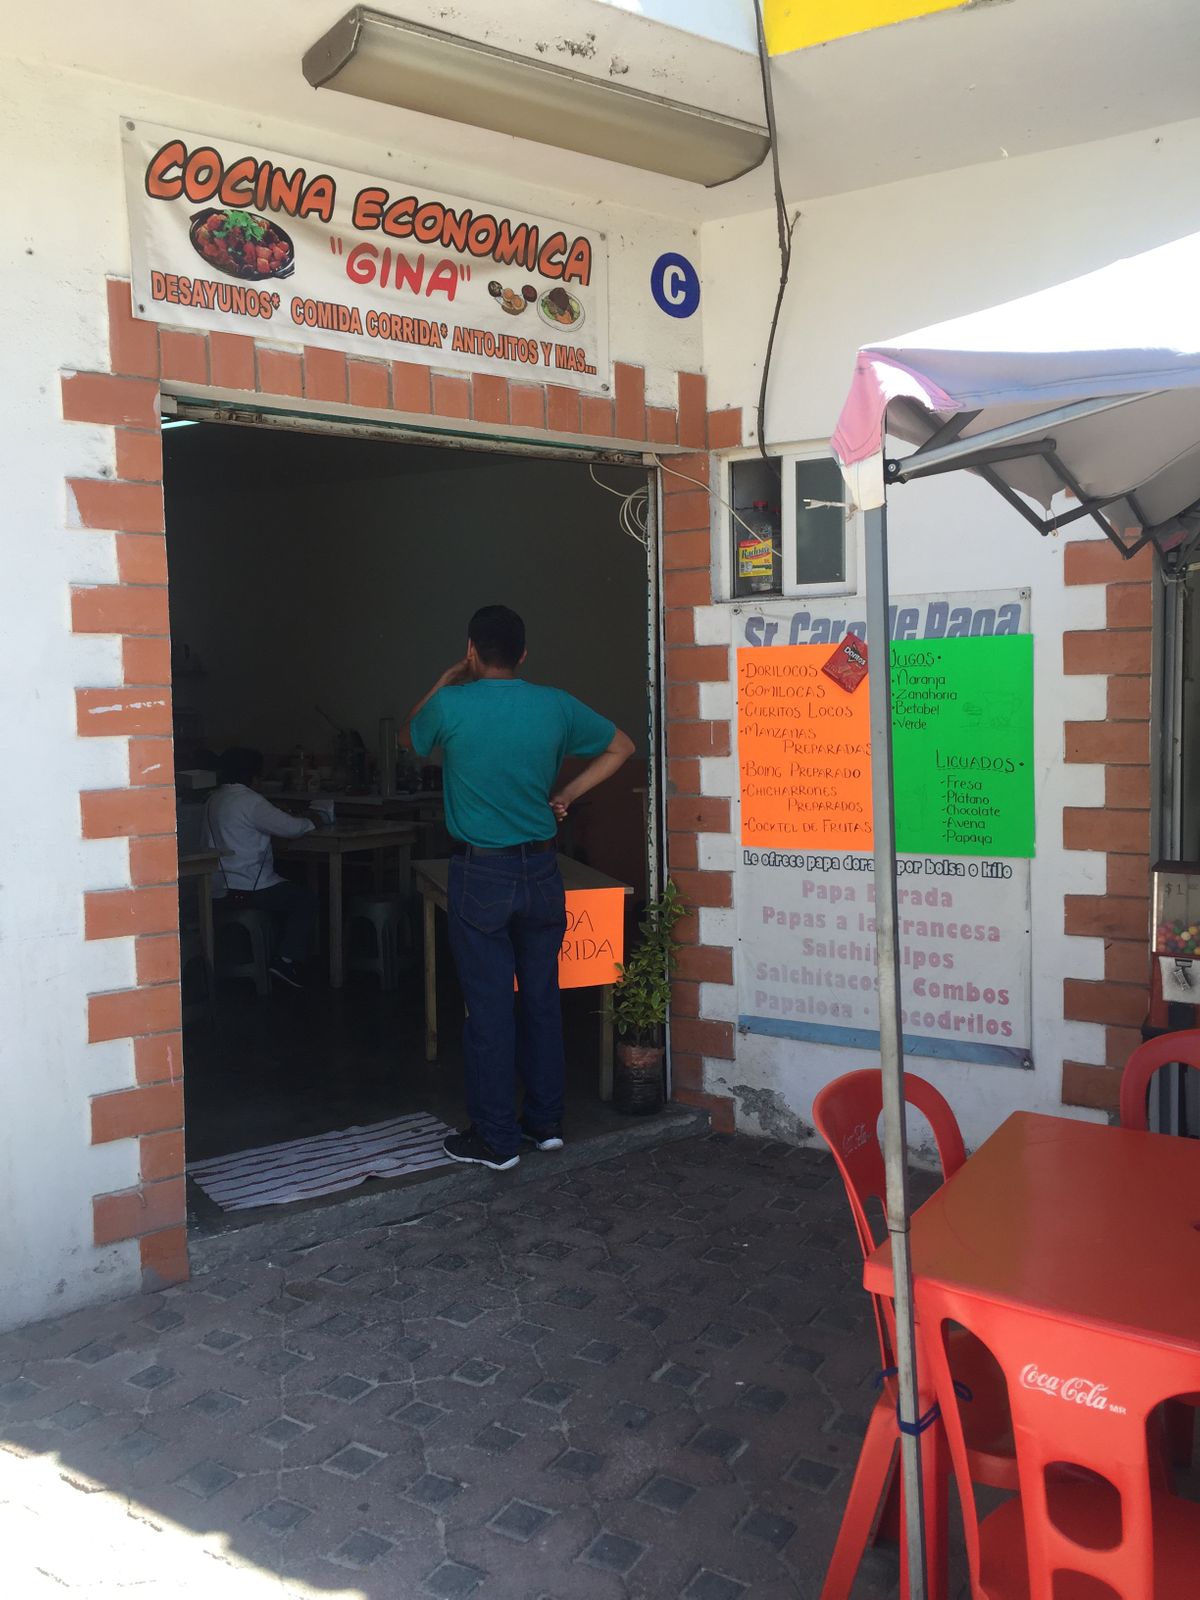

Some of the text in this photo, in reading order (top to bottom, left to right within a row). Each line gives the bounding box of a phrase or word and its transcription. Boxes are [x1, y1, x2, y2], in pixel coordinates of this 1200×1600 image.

[145, 139, 592, 287] COCINA ECONOMICA
[662, 264, 687, 306] C
[291, 296, 363, 335] COMIDA
[452, 326, 538, 365] ANTOJITOS
[541, 342, 553, 359] Y
[844, 646, 866, 665] Doritos
[745, 663, 818, 678] DORILOCOS
[897, 668, 946, 690] Naranja
[896, 688, 957, 700] Zanahoria
[745, 701, 853, 719] CUERITOS LOCOS
[895, 700, 940, 715] Betabel
[896, 716, 927, 730] Verde
[784, 740, 872, 756] PREPARADAS
[936, 748, 1015, 773] LICUADOS
[790, 761, 861, 779] PREPARADO
[947, 774, 982, 790] Fresa
[788, 798, 863, 813] PREPARADOS
[946, 804, 1001, 817] Chocolate
[823, 819, 872, 833] FRUTAS
[947, 817, 986, 829] Avena
[947, 829, 993, 846] Papaya
[743, 850, 759, 866] Le
[761, 851, 805, 869] ofrece
[807, 855, 840, 872] papa
[896, 859, 922, 876] por
[925, 858, 965, 877] bolsa
[969, 863, 979, 878] o
[982, 861, 1013, 879] kilo
[802, 879, 856, 904] Papa
[762, 905, 826, 930] Papas
[836, 914, 848, 931] a
[898, 915, 1001, 942] rancesa
[912, 976, 1010, 1006] Combos
